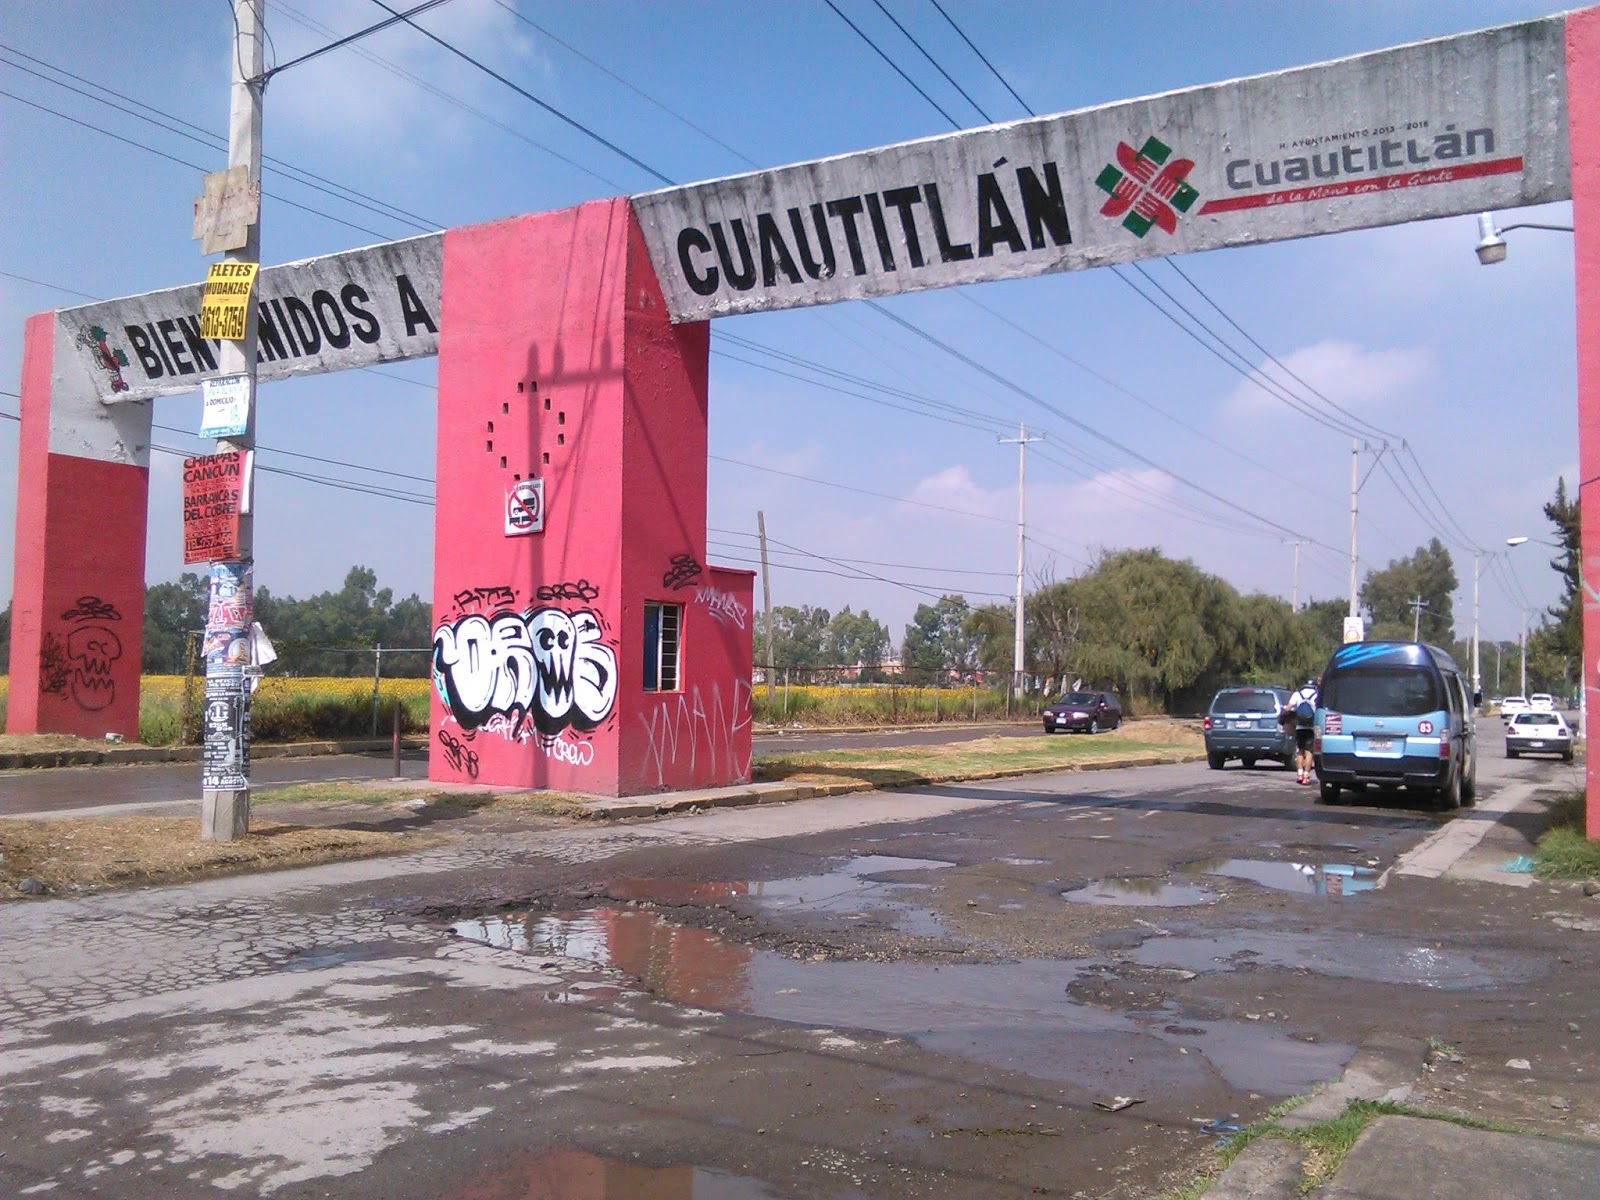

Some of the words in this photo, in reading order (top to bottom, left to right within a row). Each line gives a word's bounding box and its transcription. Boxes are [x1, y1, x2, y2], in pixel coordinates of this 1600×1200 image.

[1292, 130, 1369, 148] AYUNTAMIENTO
[1373, 126, 1396, 136] 2013
[1226, 124, 1496, 190] Cuautitlán
[1308, 185, 1349, 200] Mano
[1354, 183, 1381, 193] con
[1387, 176, 1401, 189] la
[1407, 170, 1454, 187] Gente
[676, 156, 1072, 296] CUAUTITLÁN
[210, 264, 252, 277] FLETES
[205, 281, 250, 295] MUDANZAS
[124, 283, 381, 380] BIENNIDOS
[396, 274, 439, 337] A
[183, 452, 240, 469] CHIAPAS
[183, 463, 240, 483] CANCUN
[184, 489, 239, 509] BARRANCAS
[184, 508, 204, 521] DEL
[205, 502, 237, 519] COBRE
[1420, 722, 1432, 733] 83
